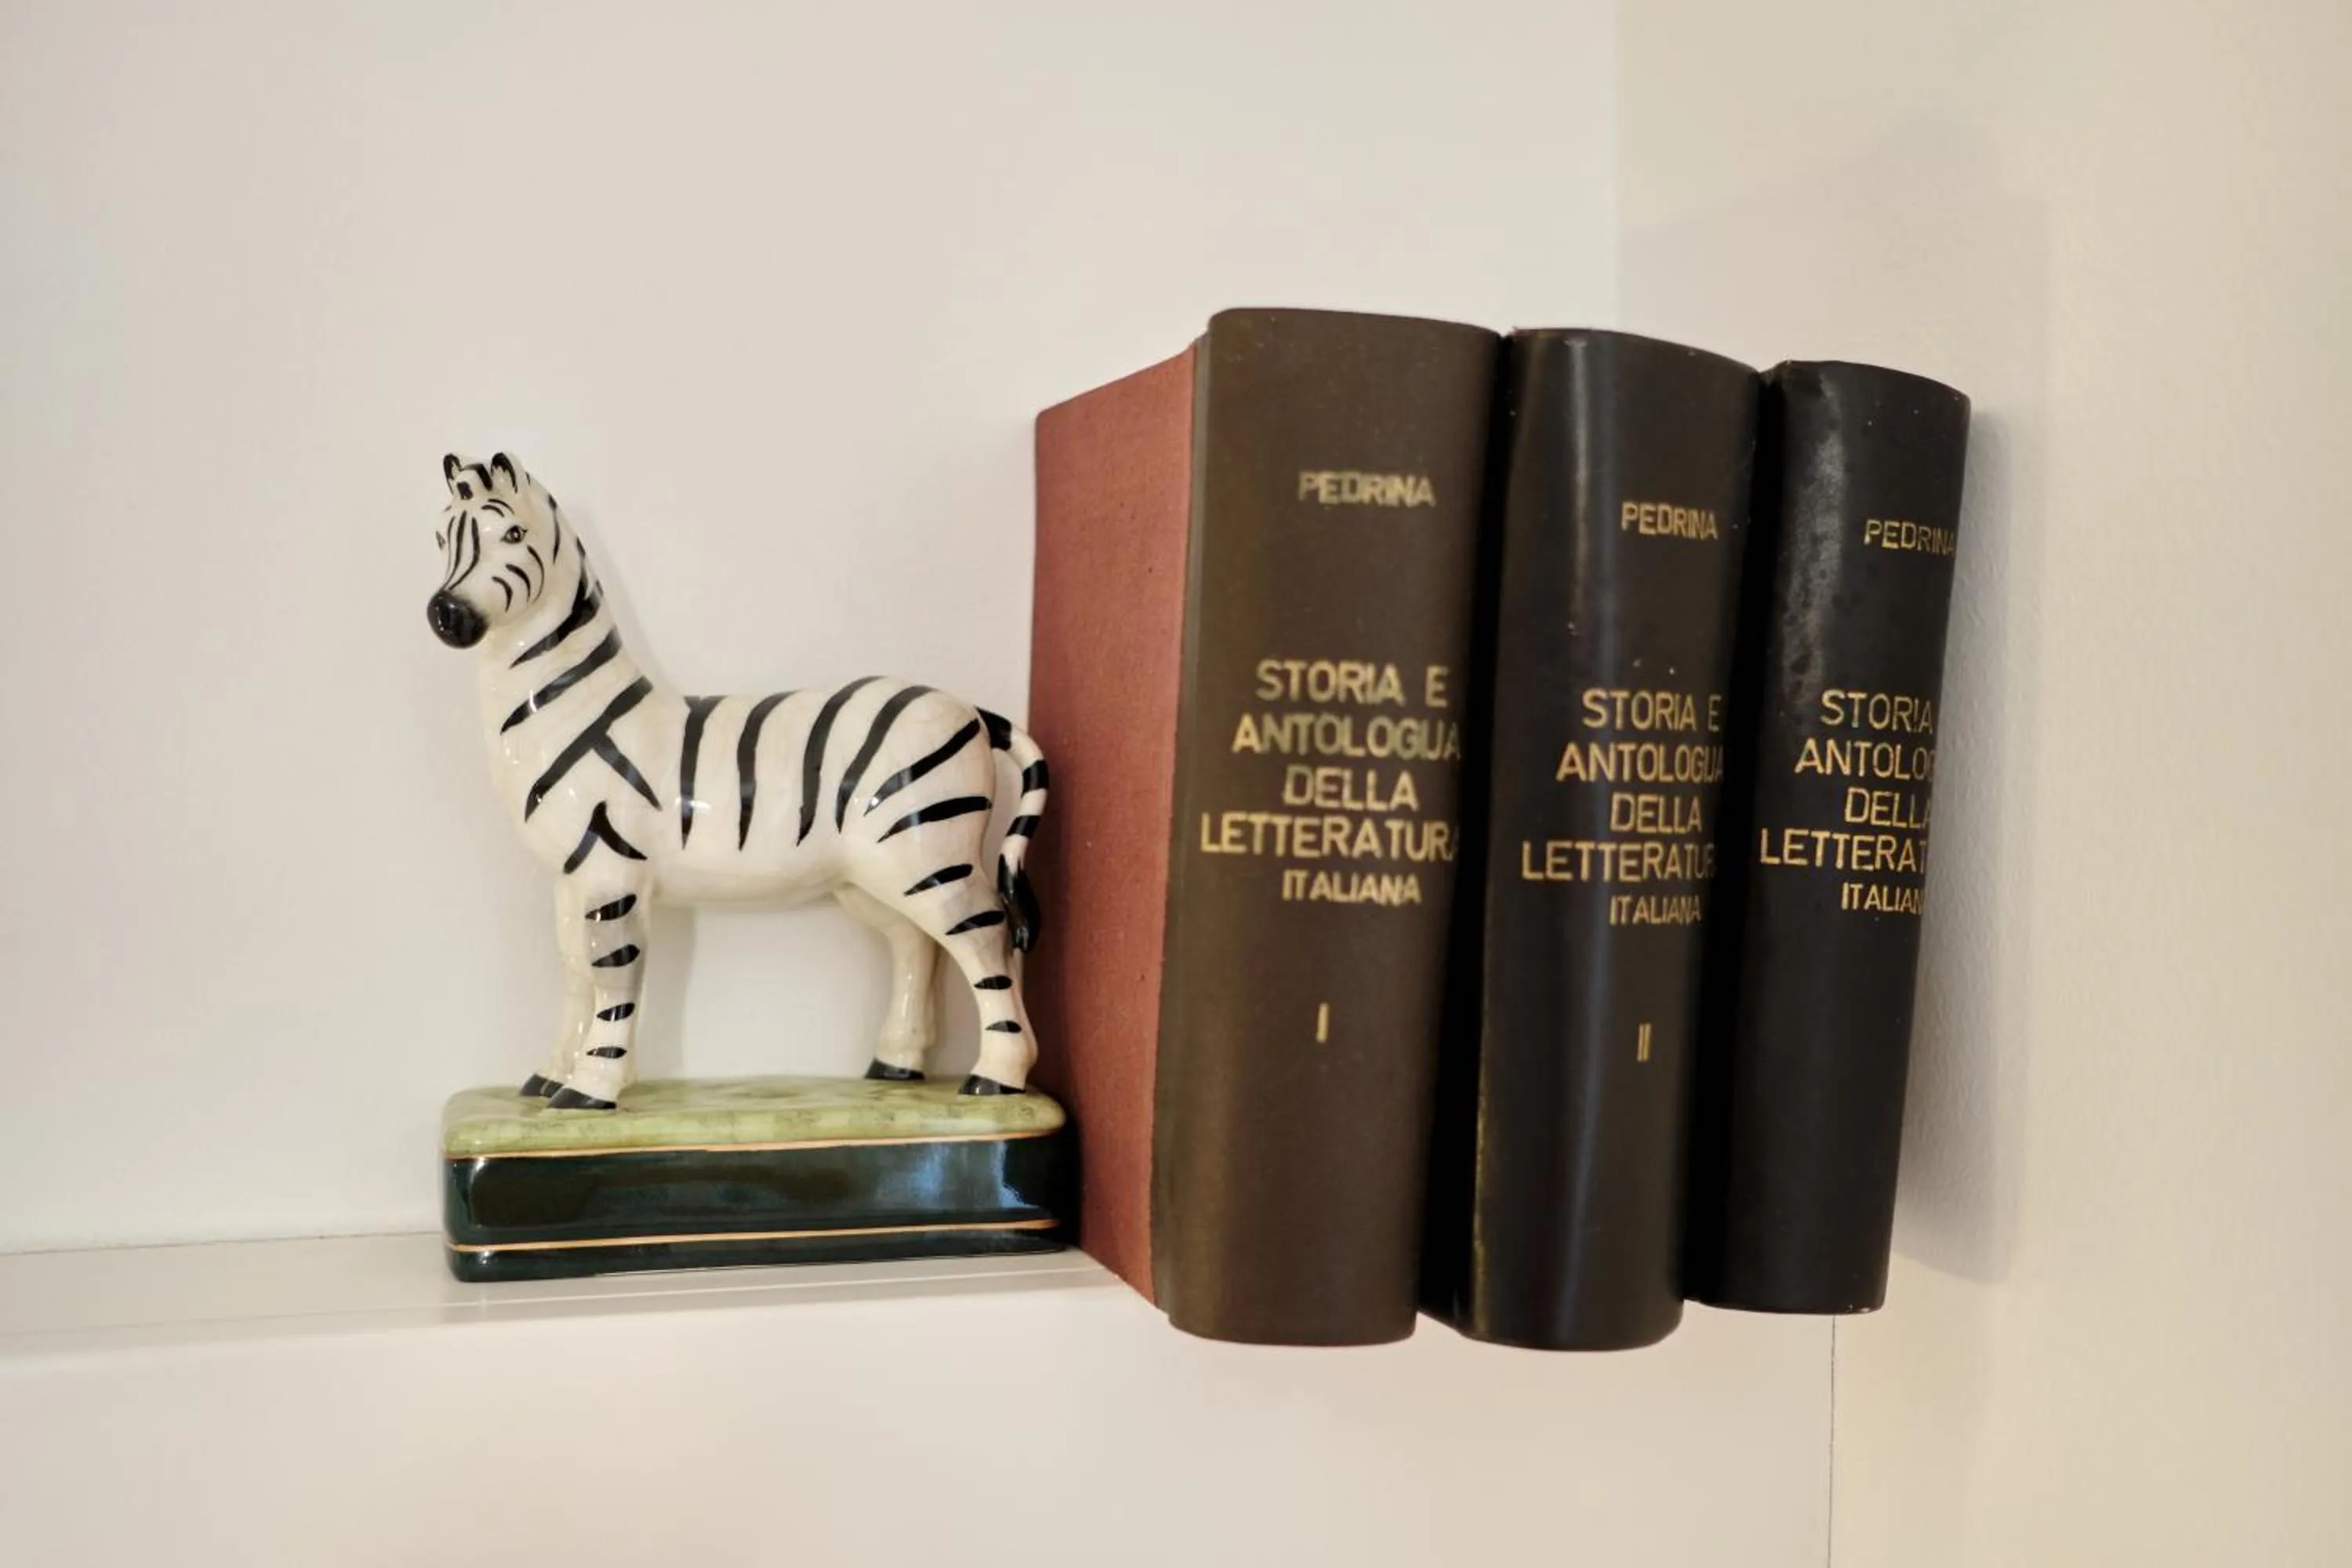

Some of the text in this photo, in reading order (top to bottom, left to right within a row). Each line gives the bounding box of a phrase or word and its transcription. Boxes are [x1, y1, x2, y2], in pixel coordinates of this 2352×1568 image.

[1298, 470, 1436, 507] PEDRINA
[1621, 502, 1719, 540] PEDRINA
[1256, 660, 1449, 708] STORIA E
[1582, 688, 1722, 732] STORIA E
[1820, 689, 1933, 734] STORIA
[1283, 764, 1418, 811] DELLA
[1610, 792, 1702, 834] DELLA
[1282, 869, 1421, 906] ITALIANA
[1610, 895, 1701, 926] ITALIANA
[1637, 1023, 1651, 1062] II
